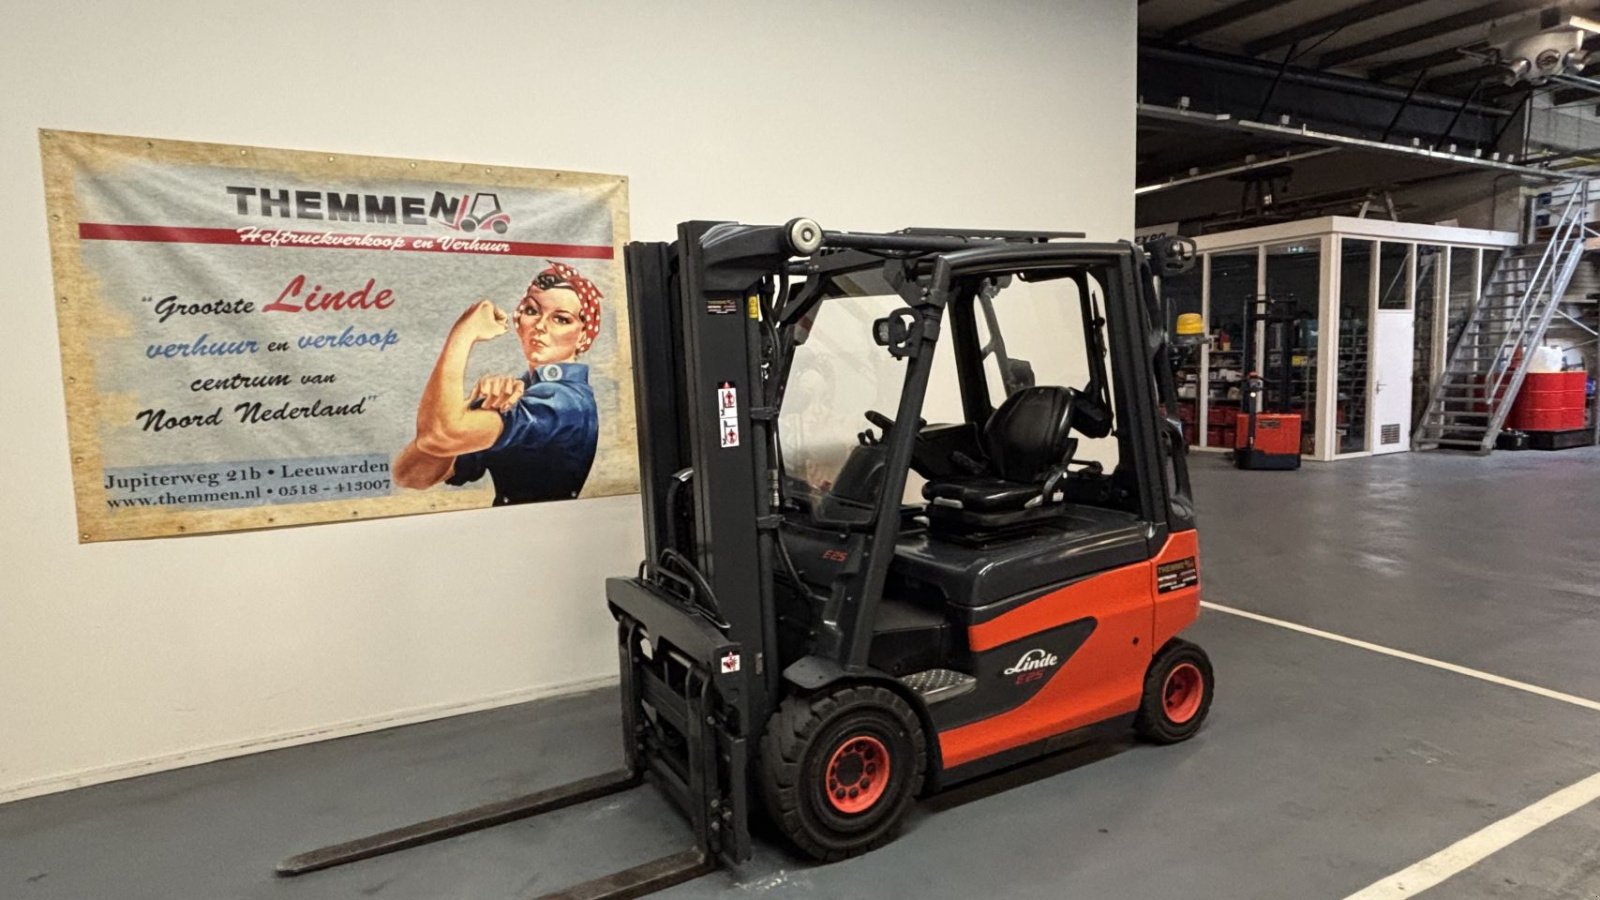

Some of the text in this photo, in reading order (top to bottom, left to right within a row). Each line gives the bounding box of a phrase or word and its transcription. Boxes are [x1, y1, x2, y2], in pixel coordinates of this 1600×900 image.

[226, 186, 460, 226] THEMMEN
[236, 226, 510, 252] Heftruckverkoop en Verhuur
[261, 274, 396, 312] Linde
[146, 325, 399, 358] verhuur en verkoop
[190, 373, 337, 391] centrum van
[136, 406, 223, 432] Noord
[104, 460, 390, 492] Jupiterweg 21b Leeuwarden
[106, 486, 261, 508] www.themmen.nl
[278, 484, 318, 497] 0518
[334, 479, 391, 493] 413007
[1004, 648, 1058, 675] Linde
